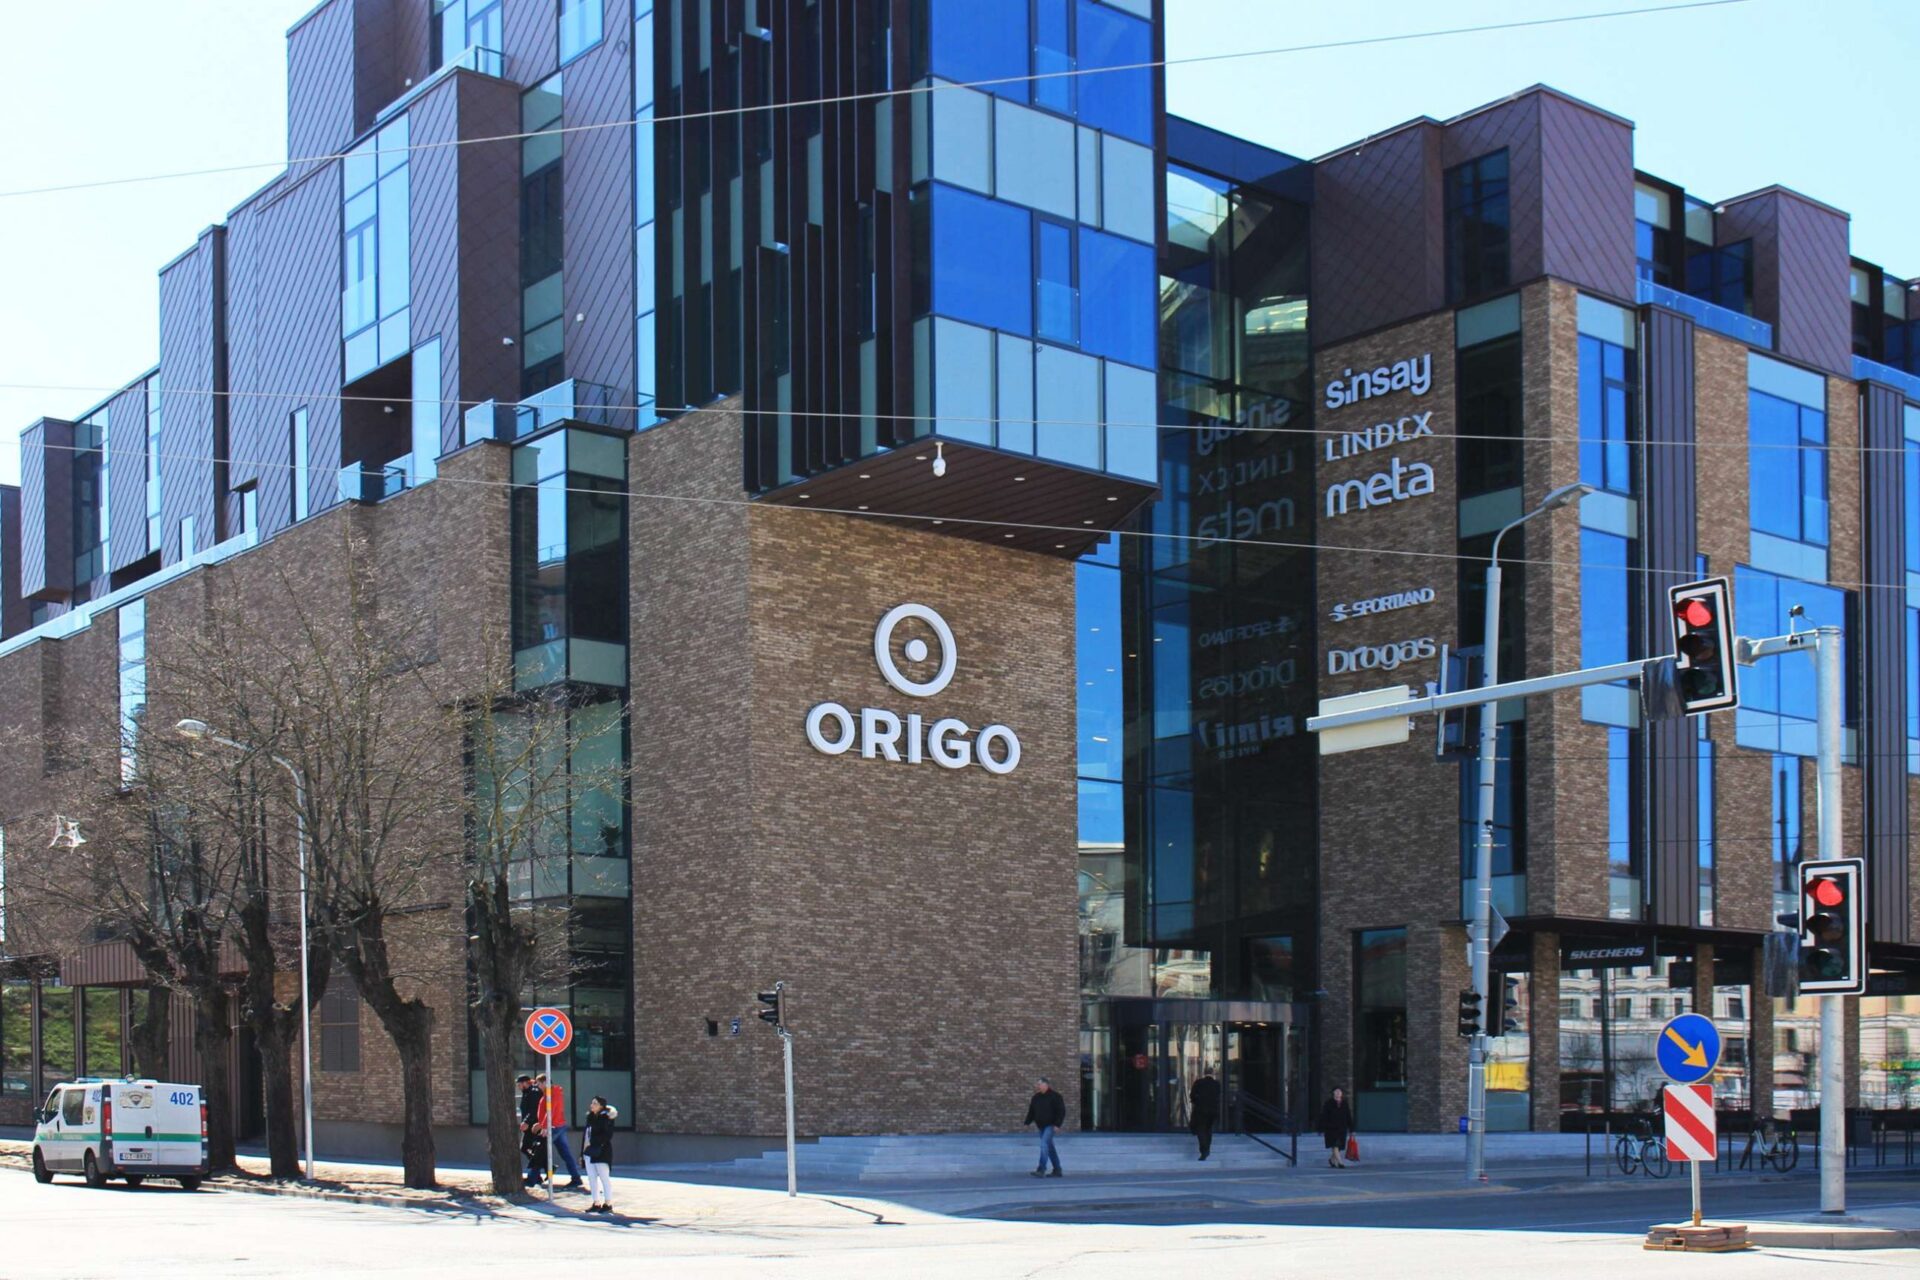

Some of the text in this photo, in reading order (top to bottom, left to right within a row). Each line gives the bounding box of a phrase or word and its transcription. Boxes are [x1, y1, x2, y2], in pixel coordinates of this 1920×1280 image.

[1326, 353, 1432, 409] sinsay
[1326, 411, 1434, 462] LINDEX
[1326, 457, 1435, 518] meta
[1328, 638, 1436, 675] Drogas
[805, 702, 1021, 774] ORIGO
[1570, 946, 1645, 959] SKECHERS
[170, 1092, 194, 1106] 402
